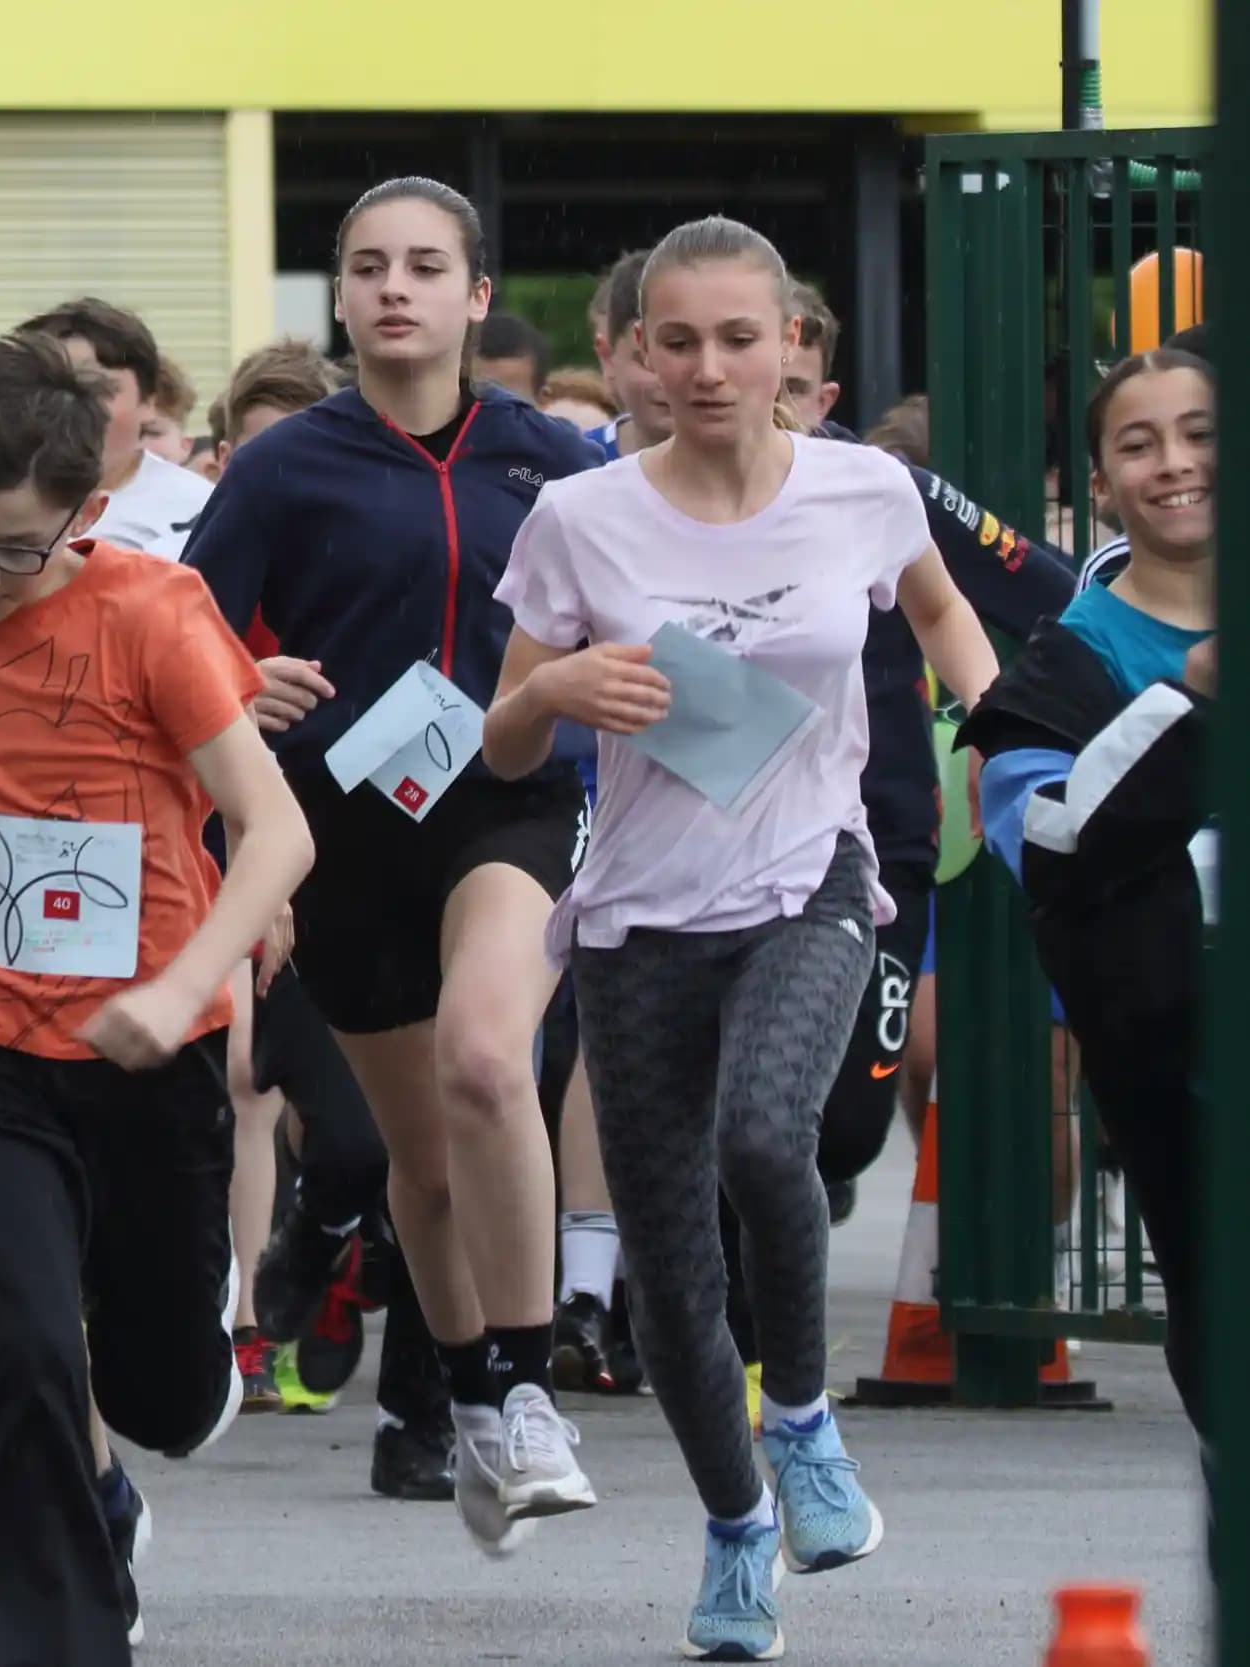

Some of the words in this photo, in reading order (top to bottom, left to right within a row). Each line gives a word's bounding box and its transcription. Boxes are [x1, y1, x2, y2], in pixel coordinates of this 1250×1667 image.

[508, 467, 544, 488] FILA
[404, 785, 420, 802] 28
[52, 896, 71, 910] 40
[878, 951, 910, 1052] CR7
